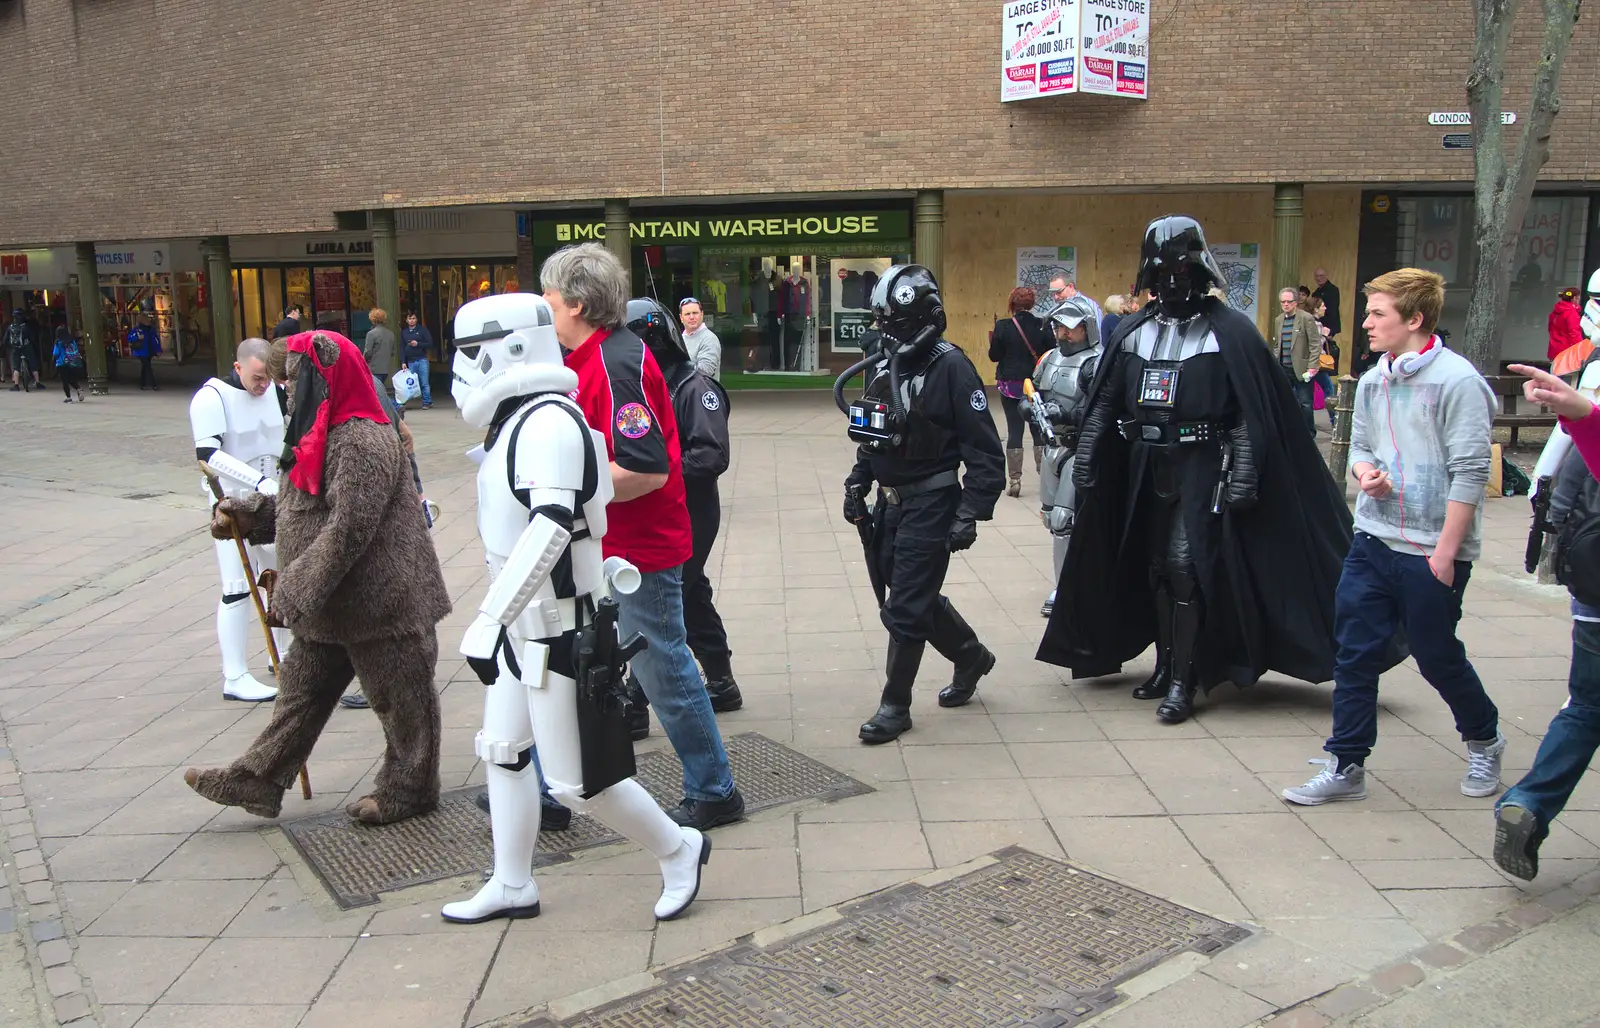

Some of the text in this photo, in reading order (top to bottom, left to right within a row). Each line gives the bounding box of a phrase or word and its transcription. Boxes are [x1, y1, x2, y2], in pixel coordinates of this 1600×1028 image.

[1008, 1, 1039, 18] LARGE
[1084, 36, 1093, 49] UP
[1433, 113, 1471, 123] LONDON
[574, 215, 879, 240] MONTAIN WAREHOUSE
[306, 242, 345, 254] LAURA
[96, 252, 135, 265] CYCLES UK
